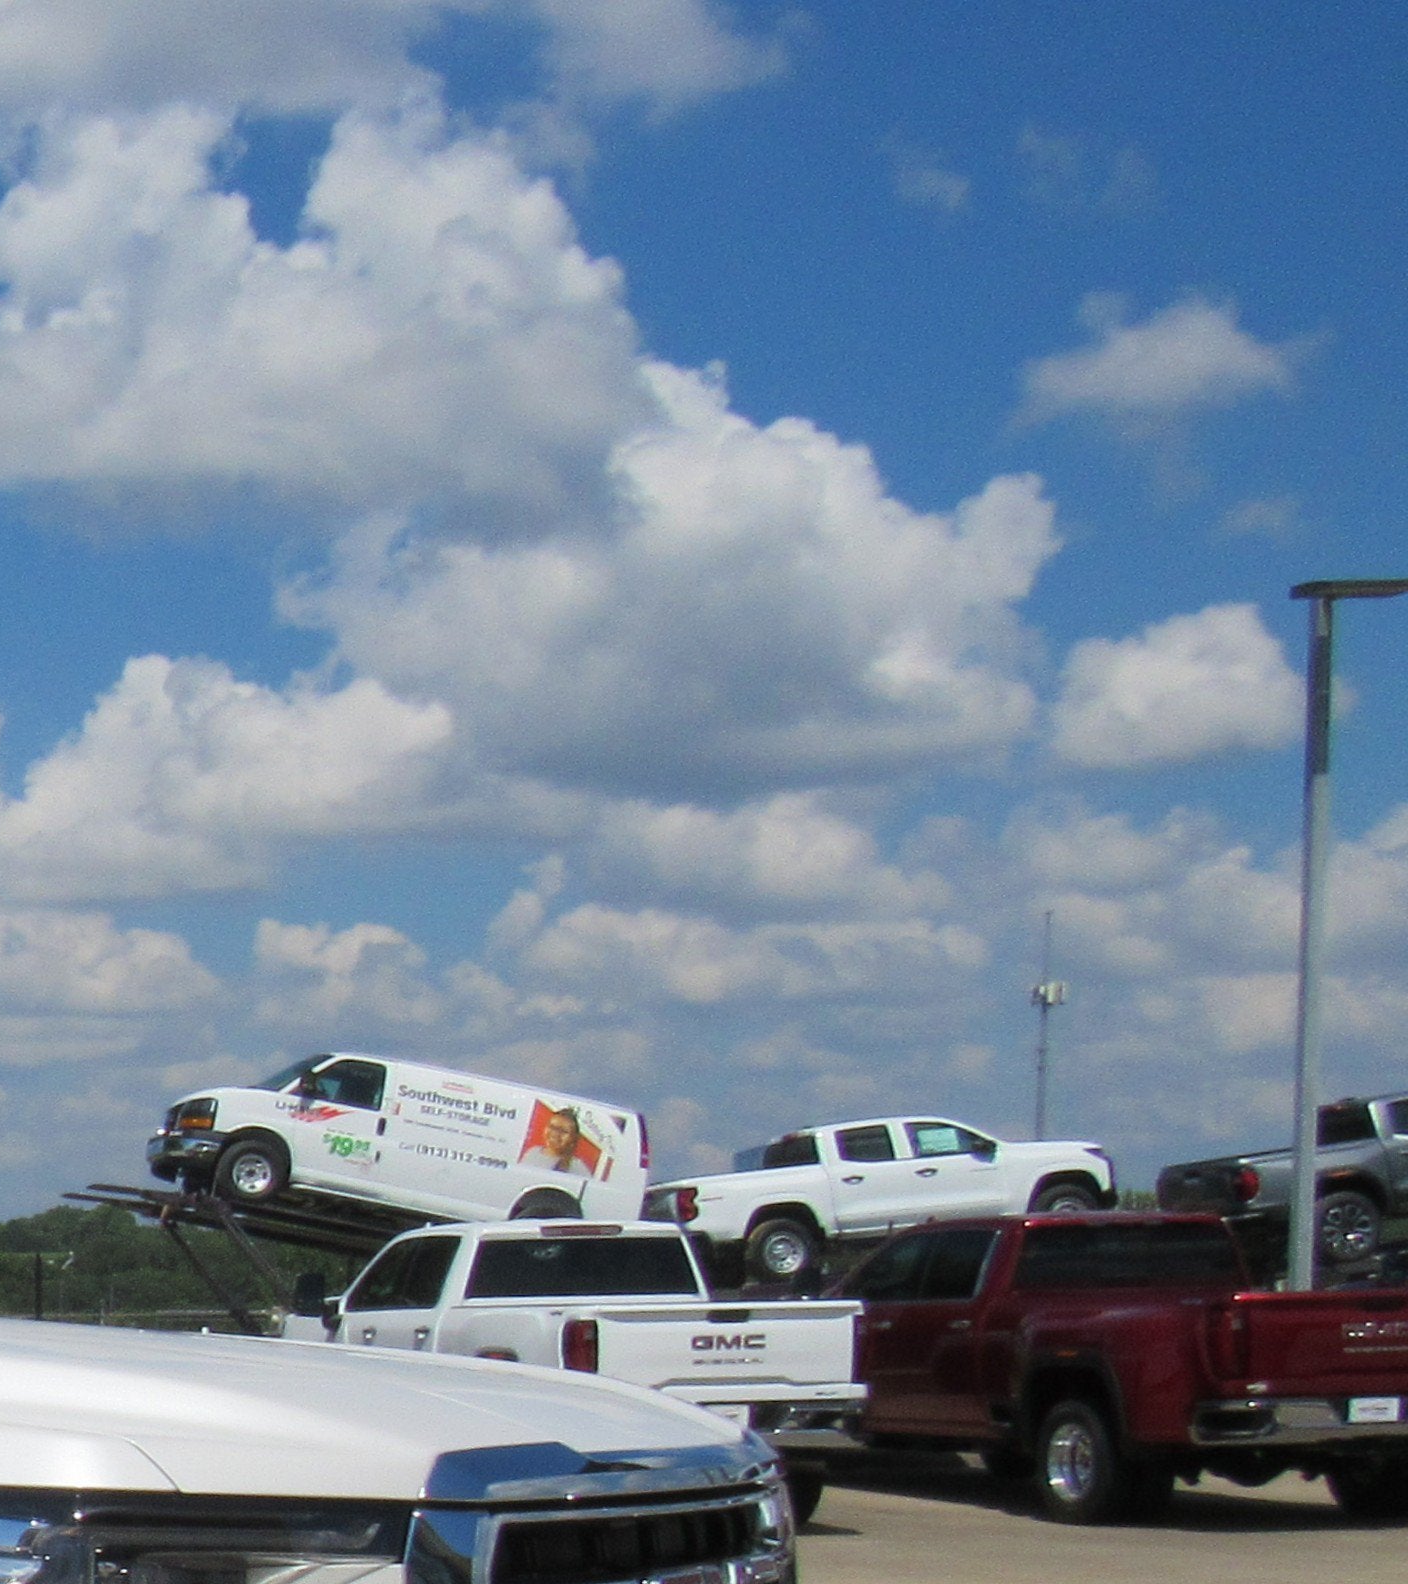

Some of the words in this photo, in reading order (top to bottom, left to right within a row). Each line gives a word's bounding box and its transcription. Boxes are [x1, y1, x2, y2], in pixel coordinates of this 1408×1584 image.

[397, 1084, 479, 1112] Southwest
[483, 1102, 517, 1120] Blvd
[691, 1334, 767, 1350] GMC
